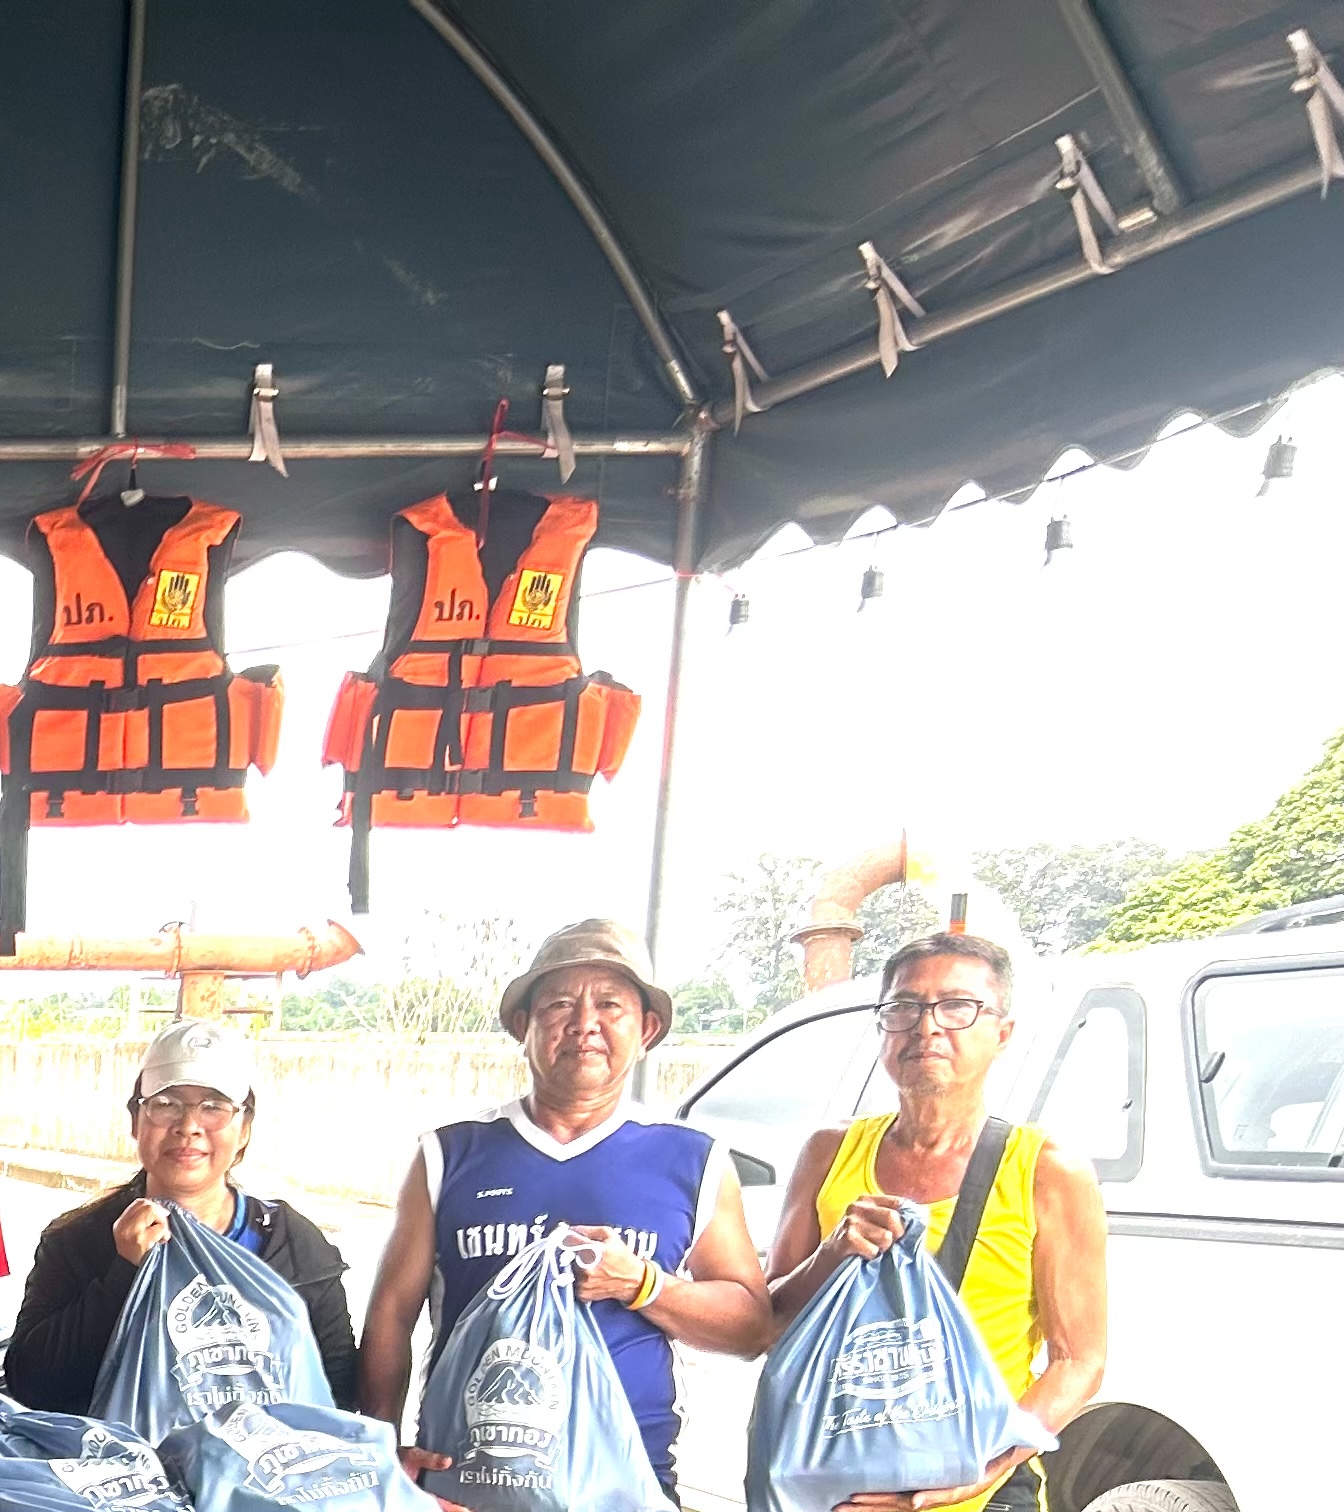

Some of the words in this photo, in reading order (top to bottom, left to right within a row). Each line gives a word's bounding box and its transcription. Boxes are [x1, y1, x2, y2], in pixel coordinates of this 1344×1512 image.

[62, 591, 114, 628] ปภ.
[434, 585, 481, 624] ปภ.
[469, 1424, 552, 1448] ภูเขาทอง
[459, 1465, 553, 1490] เราไม่ทิ้งกัน
